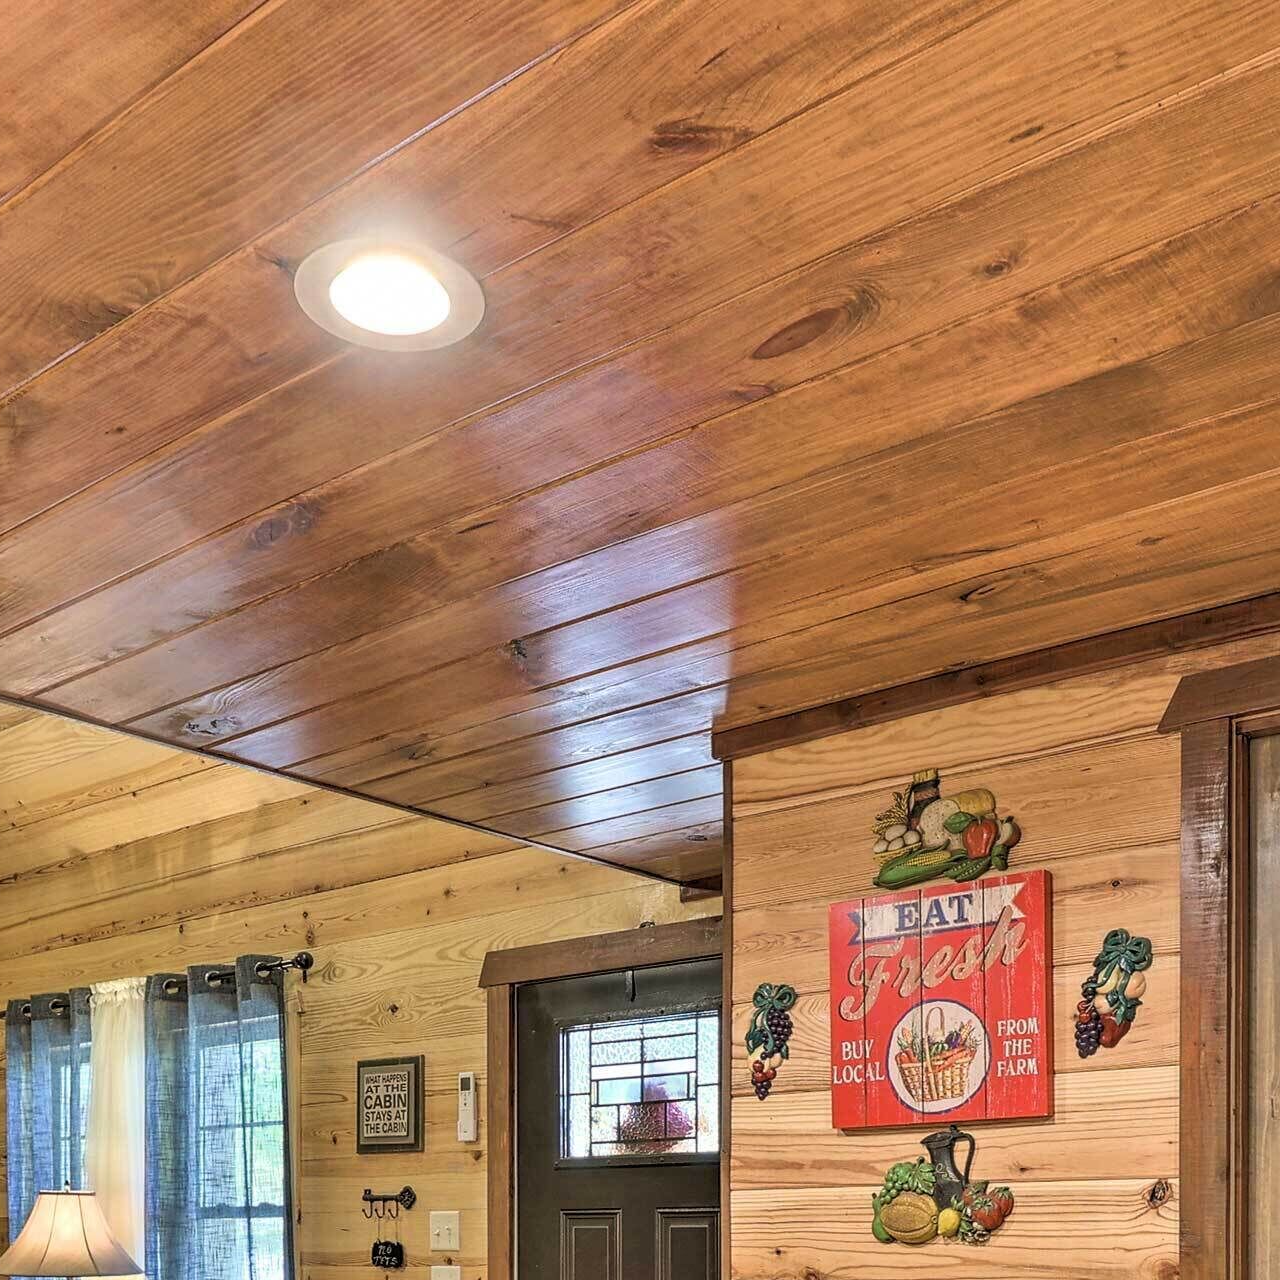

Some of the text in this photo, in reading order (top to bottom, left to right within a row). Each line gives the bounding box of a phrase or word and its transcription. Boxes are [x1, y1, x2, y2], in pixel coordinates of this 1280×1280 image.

[894, 894, 973, 932] EAT
[839, 906, 1030, 1021] Fresh
[997, 1018, 1038, 1037] FROM
[841, 1039, 875, 1061] BUY
[1003, 1038, 1032, 1057] THE
[833, 1063, 885, 1084] LOCAL
[997, 1059, 1038, 1077] FARM
[365, 1083, 407, 1094] AT THE
[364, 1094, 407, 1110] CABIN
[365, 1110, 406, 1122] STAYS AT
[365, 1122, 407, 1134] THE CABIN
